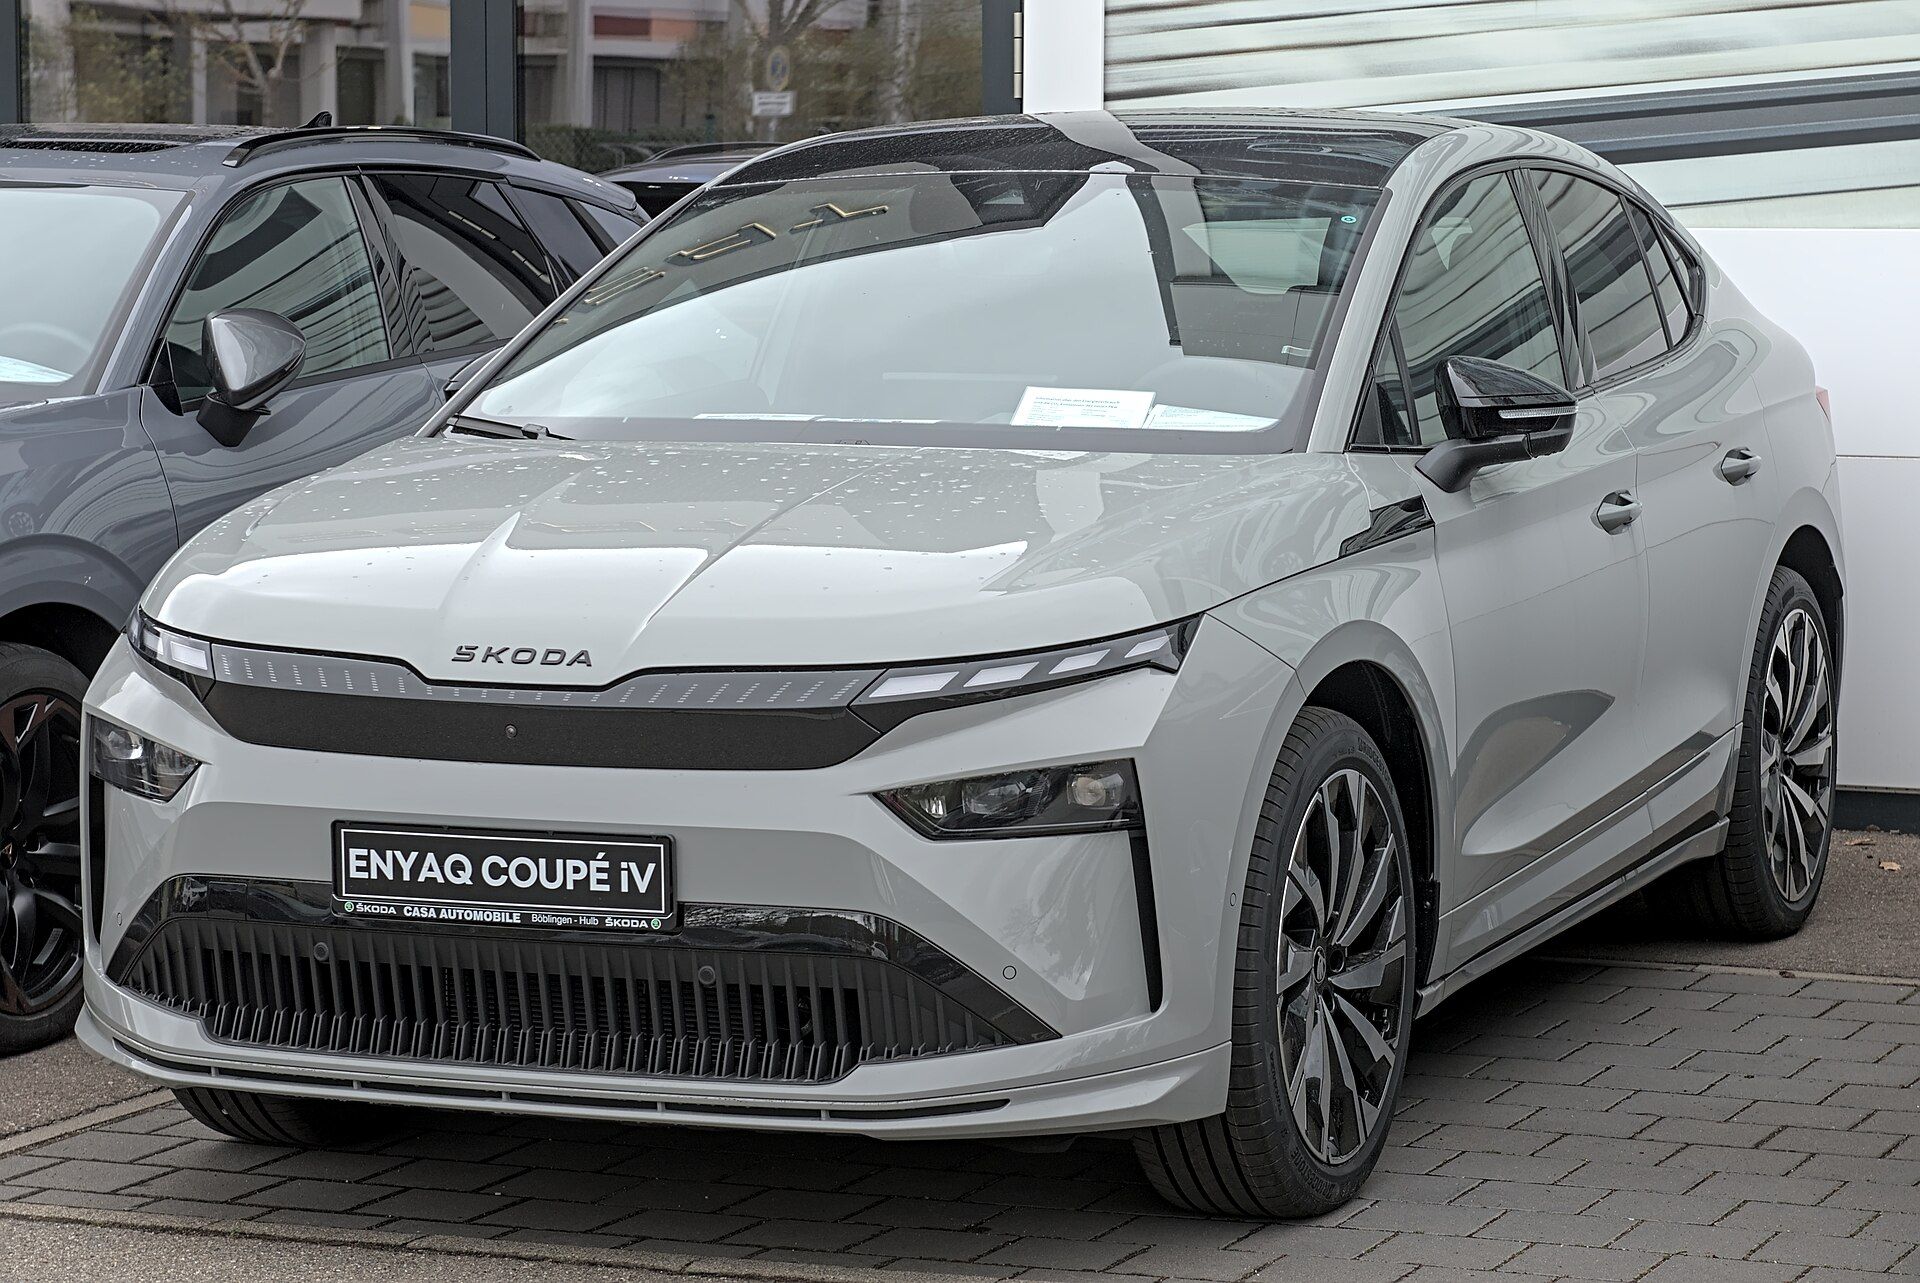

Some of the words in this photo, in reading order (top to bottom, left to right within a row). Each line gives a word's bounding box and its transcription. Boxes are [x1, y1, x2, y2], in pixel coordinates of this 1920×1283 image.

[349, 848, 473, 885] ENYAQ
[481, 852, 611, 892] COUPÉ
[620, 862, 656, 894] iV
[356, 902, 396, 915] ŠKODA
[403, 906, 437, 919] CASA
[439, 909, 521, 923] AUTOMOBILE
[531, 913, 573, 926] Böblingen
[579, 916, 599, 926] Hulb
[605, 917, 649, 928] ŠKODA
